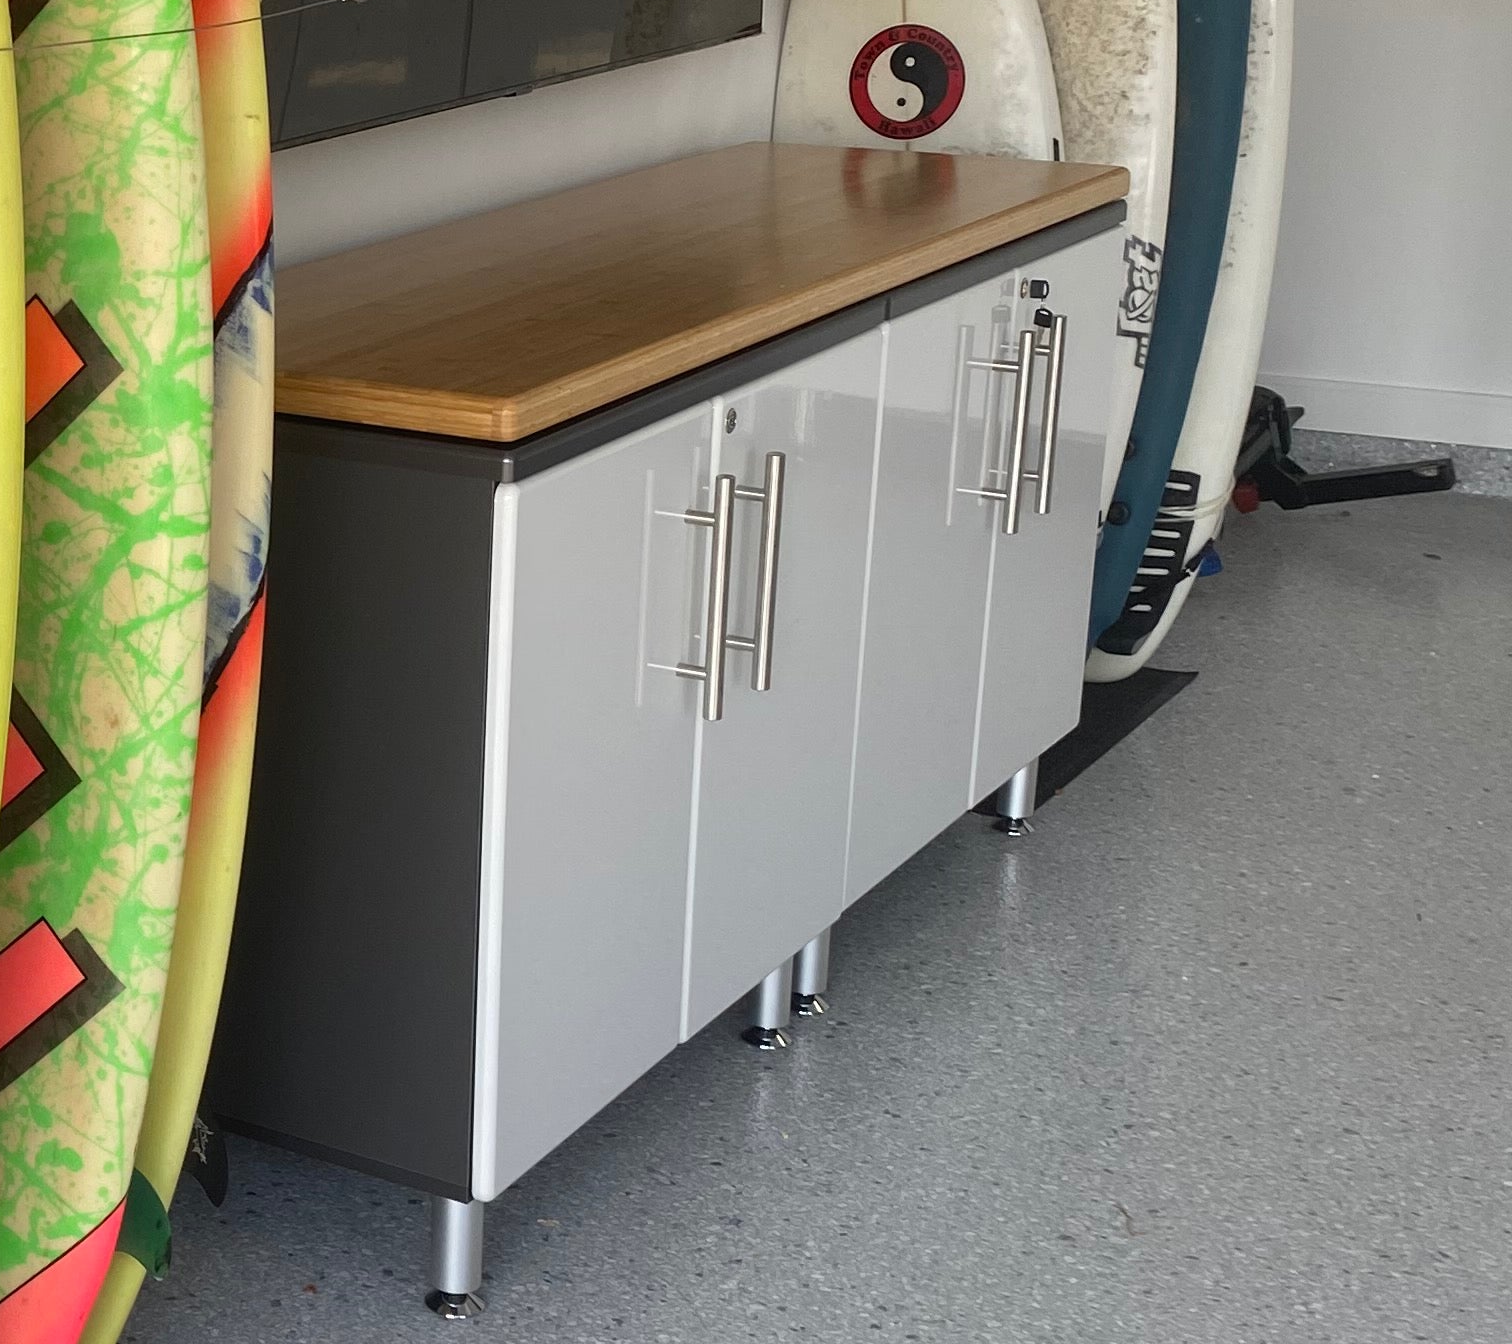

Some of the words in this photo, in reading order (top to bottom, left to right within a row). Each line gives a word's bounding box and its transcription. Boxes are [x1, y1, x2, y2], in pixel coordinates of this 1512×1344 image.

[854, 41, 886, 81] Town
[908, 28, 959, 71] Country
[879, 120, 936, 135] Hawaii
